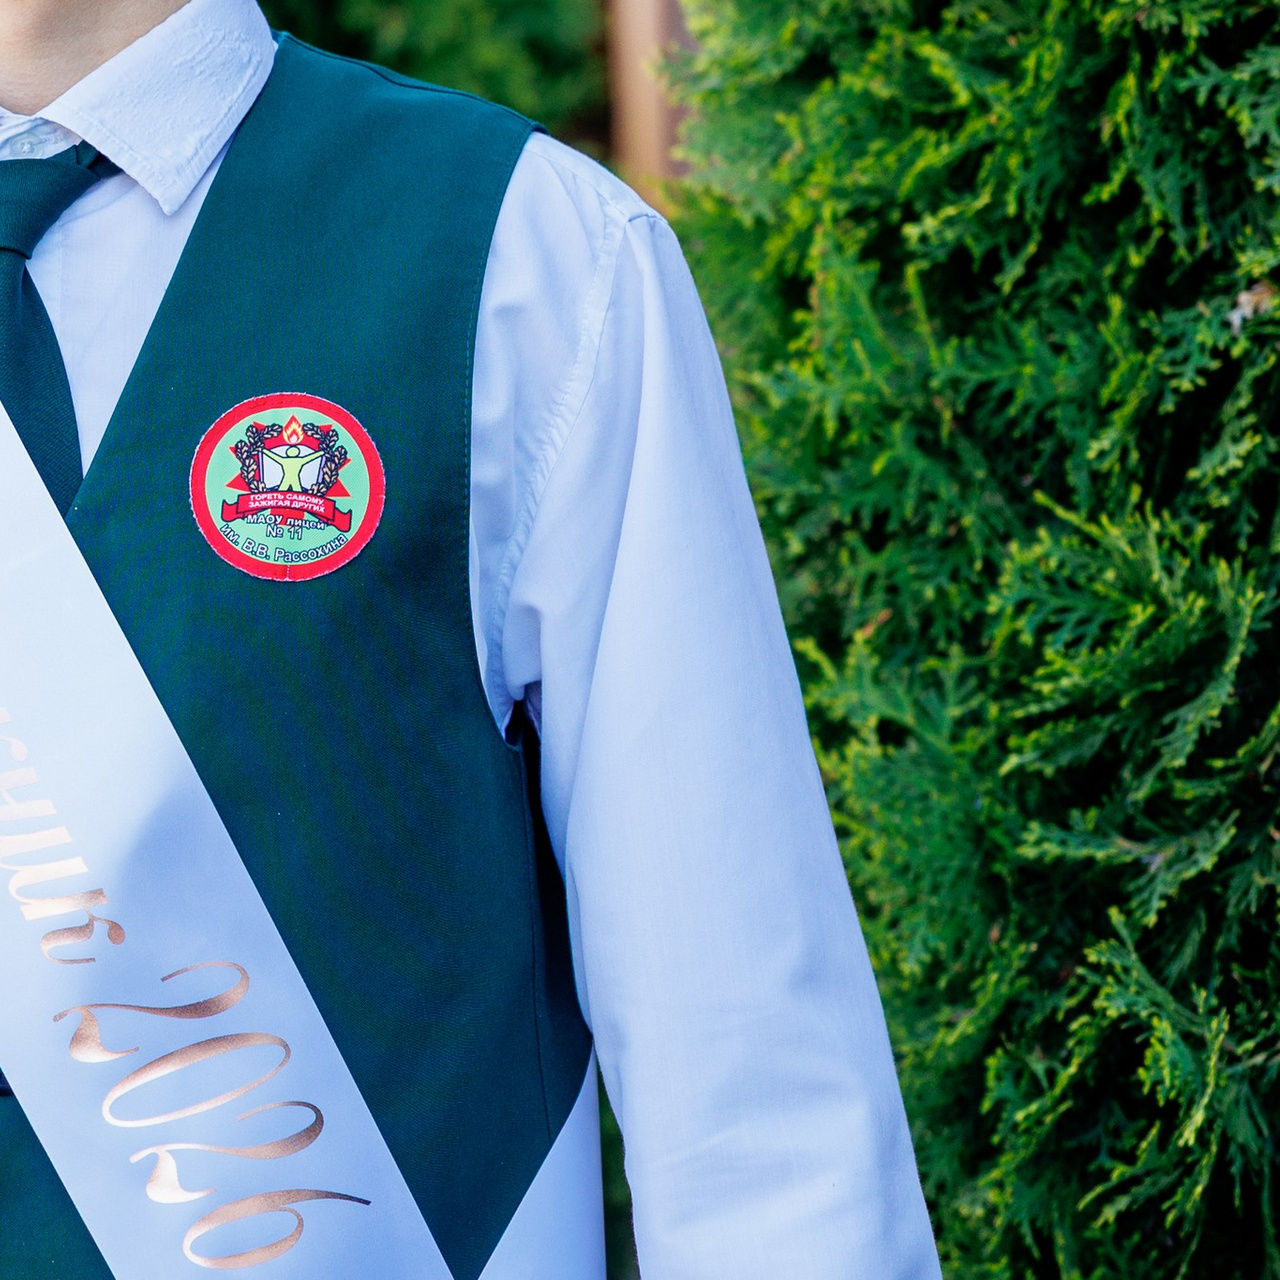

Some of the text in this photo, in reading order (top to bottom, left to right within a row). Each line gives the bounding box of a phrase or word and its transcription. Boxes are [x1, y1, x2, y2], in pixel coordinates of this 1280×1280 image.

[250, 493, 284, 501] ГОРЕТЬ
[249, 499, 326, 513] ЗАЖИГАЯ ДРУГИХ
[246, 514, 326, 530] МАОУ лицей
[266, 526, 303, 540] № 11
[220, 524, 348, 562] им. В.В. Рассохина
[52, 960, 372, 1270] 2026
